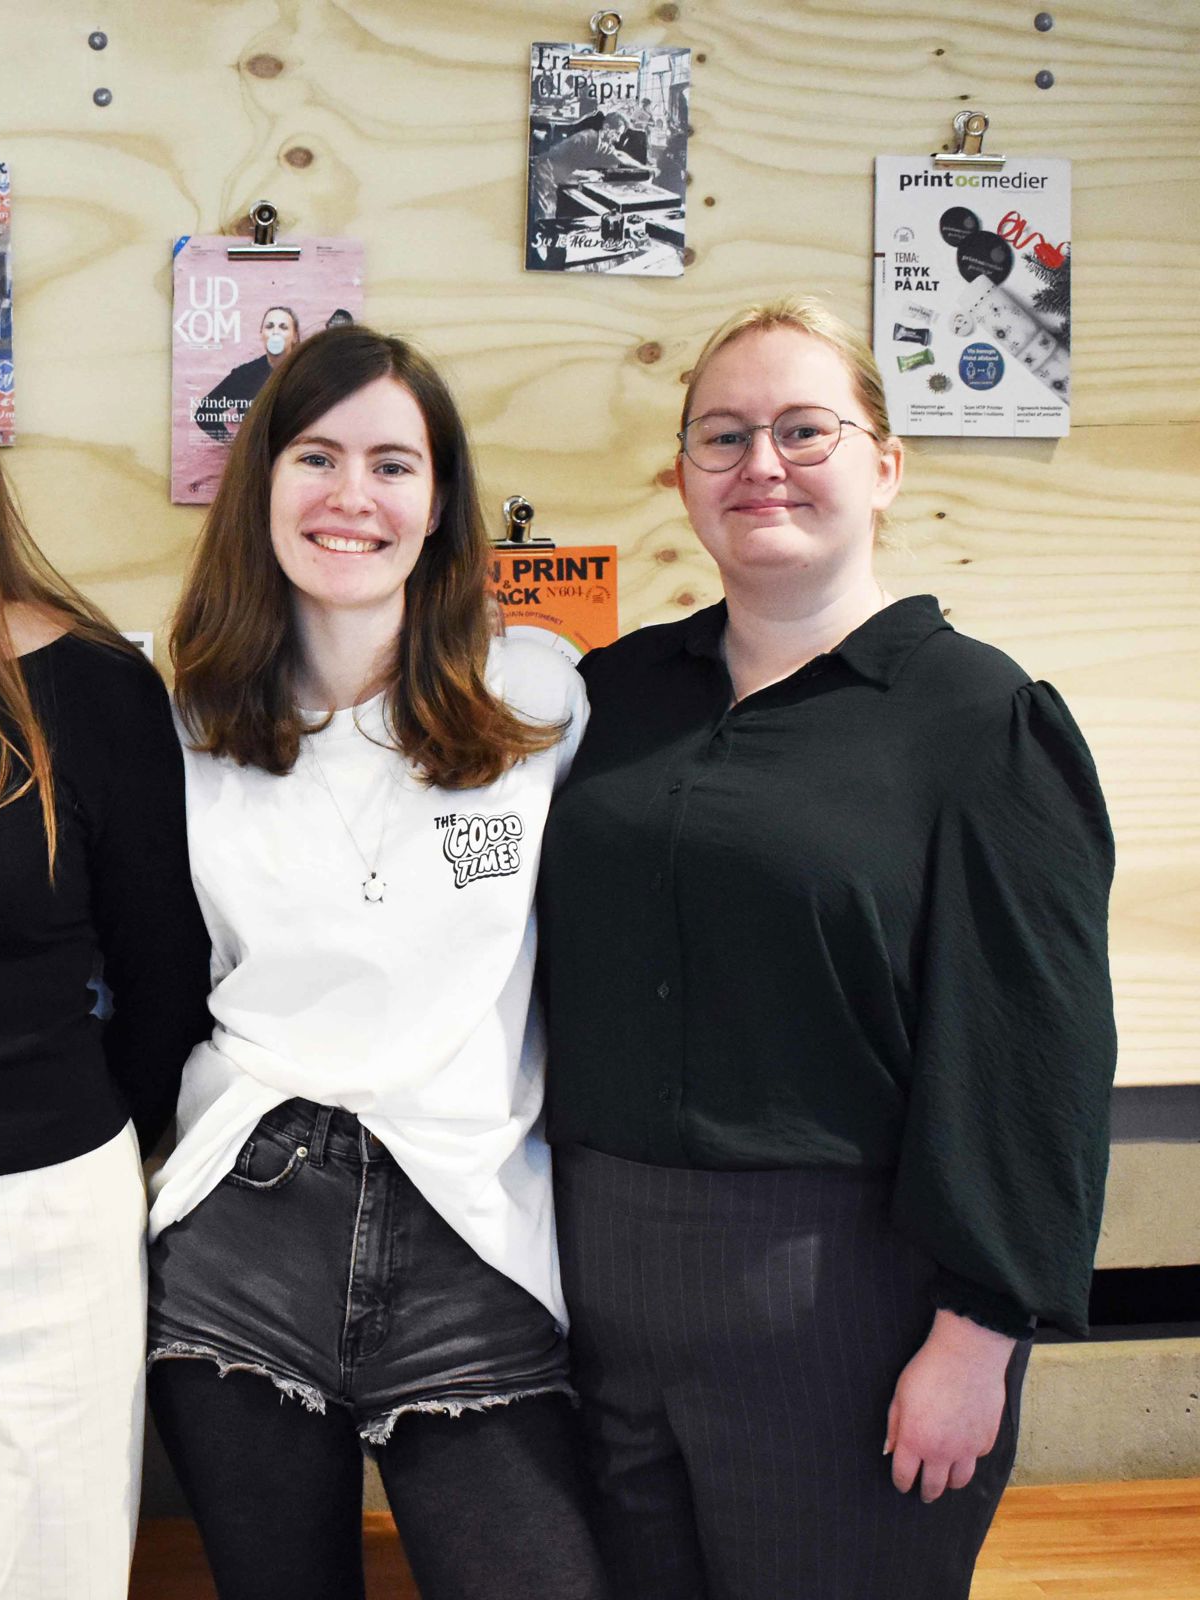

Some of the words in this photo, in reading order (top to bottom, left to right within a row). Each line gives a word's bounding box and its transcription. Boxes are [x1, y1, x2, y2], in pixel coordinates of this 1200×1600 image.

[894, 252, 919, 264] TEMA:
[894, 266, 930, 277] TRYK
[188, 276, 239, 310] UD
[894, 277, 913, 291] PÅ
[915, 280, 939, 291] ALT
[174, 309, 241, 344] KOM
[190, 412, 246, 422] kommer
[512, 556, 610, 582] PRINT
[496, 587, 541, 606] ACK
[434, 814, 456, 830] THE
[446, 813, 523, 861] GOOD
[456, 840, 521, 887] TIMES
